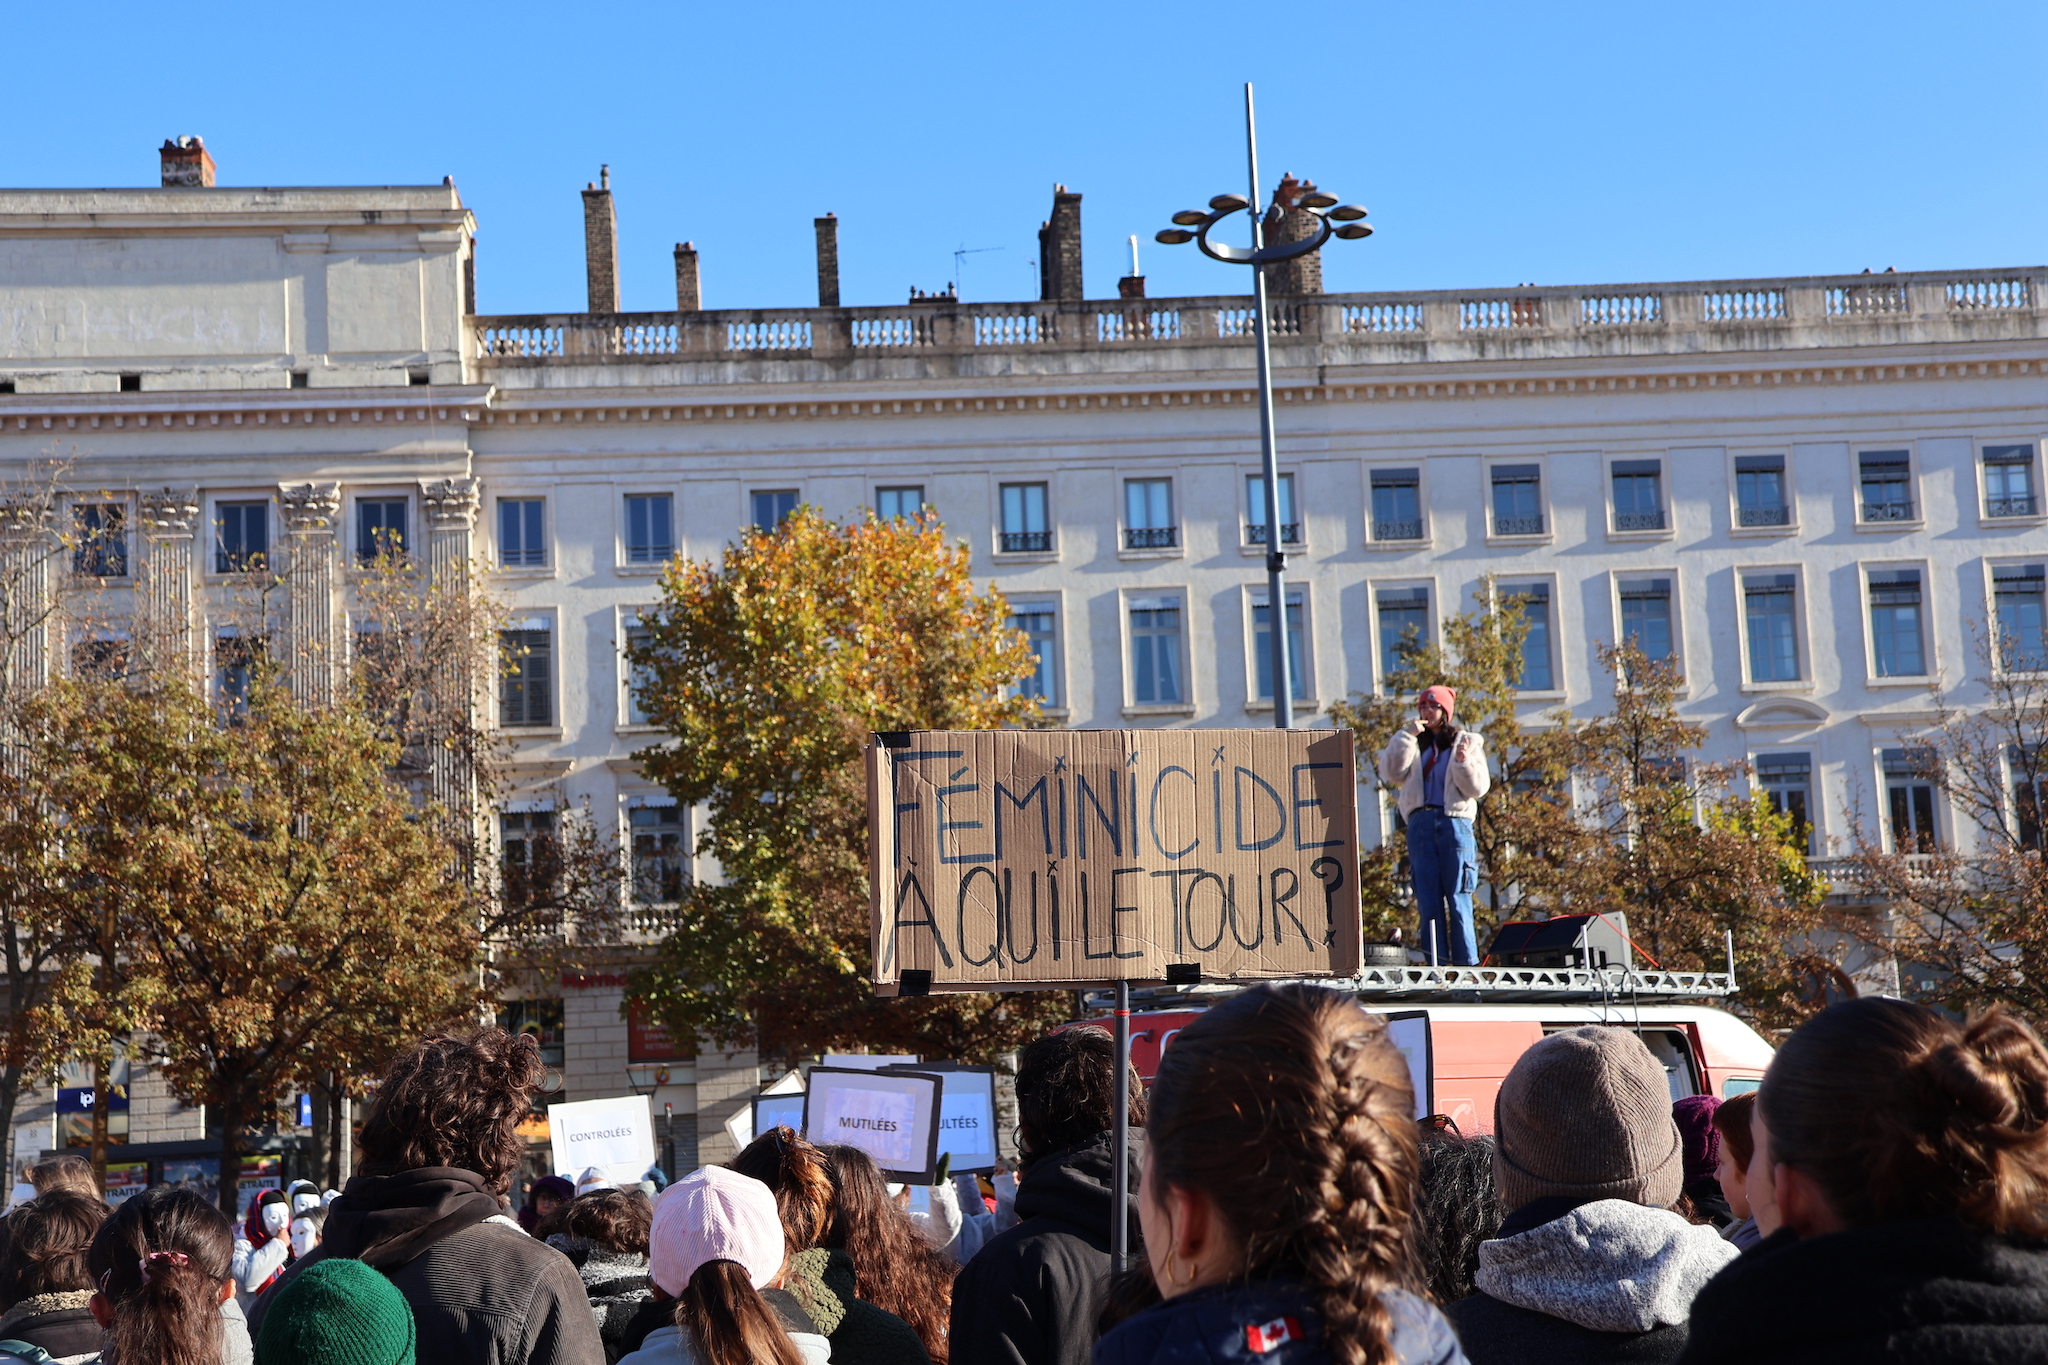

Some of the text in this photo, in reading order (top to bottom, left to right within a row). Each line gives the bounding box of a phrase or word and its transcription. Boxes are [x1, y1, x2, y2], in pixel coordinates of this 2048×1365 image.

[1080, 867, 1145, 960] LE
[839, 1116, 897, 1132] MUTILÉES
[939, 1115, 978, 1129] ULTÉES
[569, 1125, 632, 1143] CONTROLÉES
